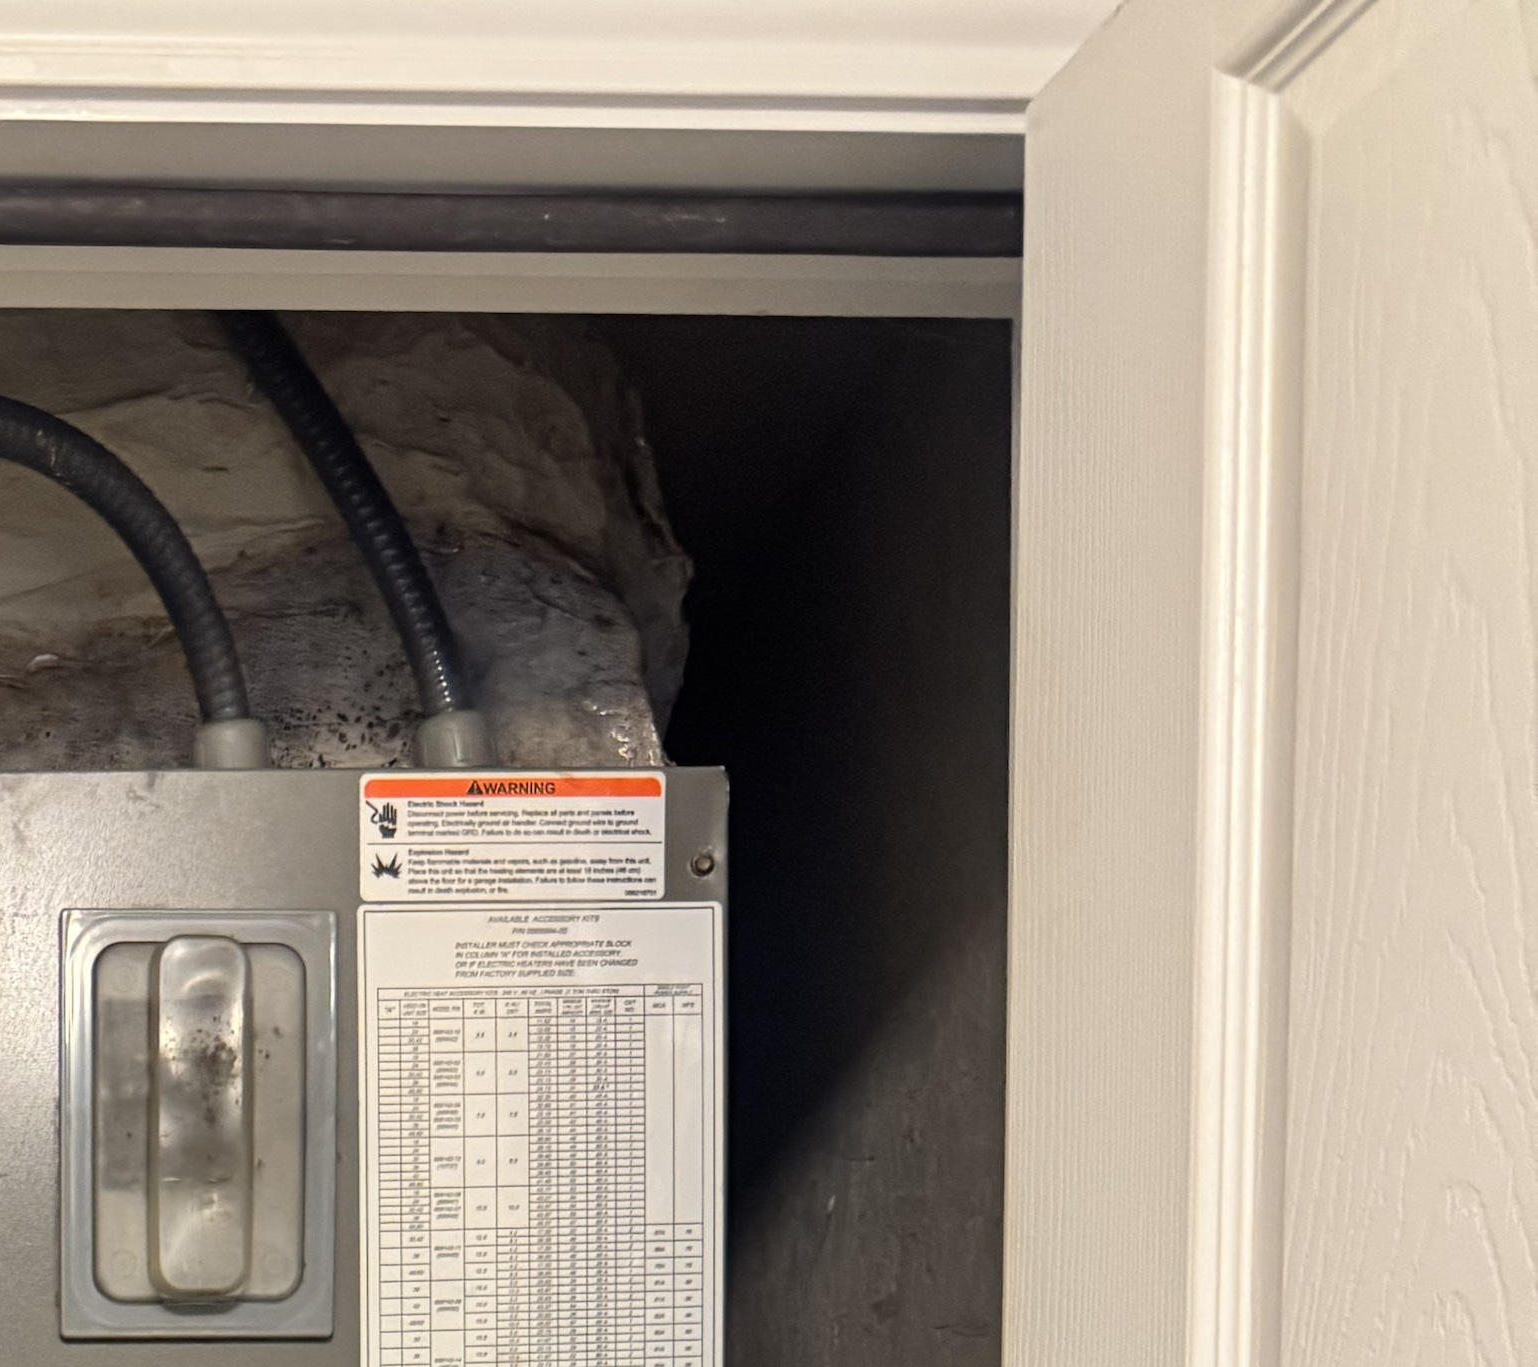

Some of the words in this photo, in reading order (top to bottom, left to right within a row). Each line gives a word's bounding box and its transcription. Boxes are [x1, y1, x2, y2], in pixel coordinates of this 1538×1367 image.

[483, 782, 556, 795] WARNING
[454, 941, 497, 949] INSTALLER
[477, 960, 515, 968] ELECTRIC
[554, 959, 575, 967] HAVE
[599, 958, 638, 966] CHANGED
